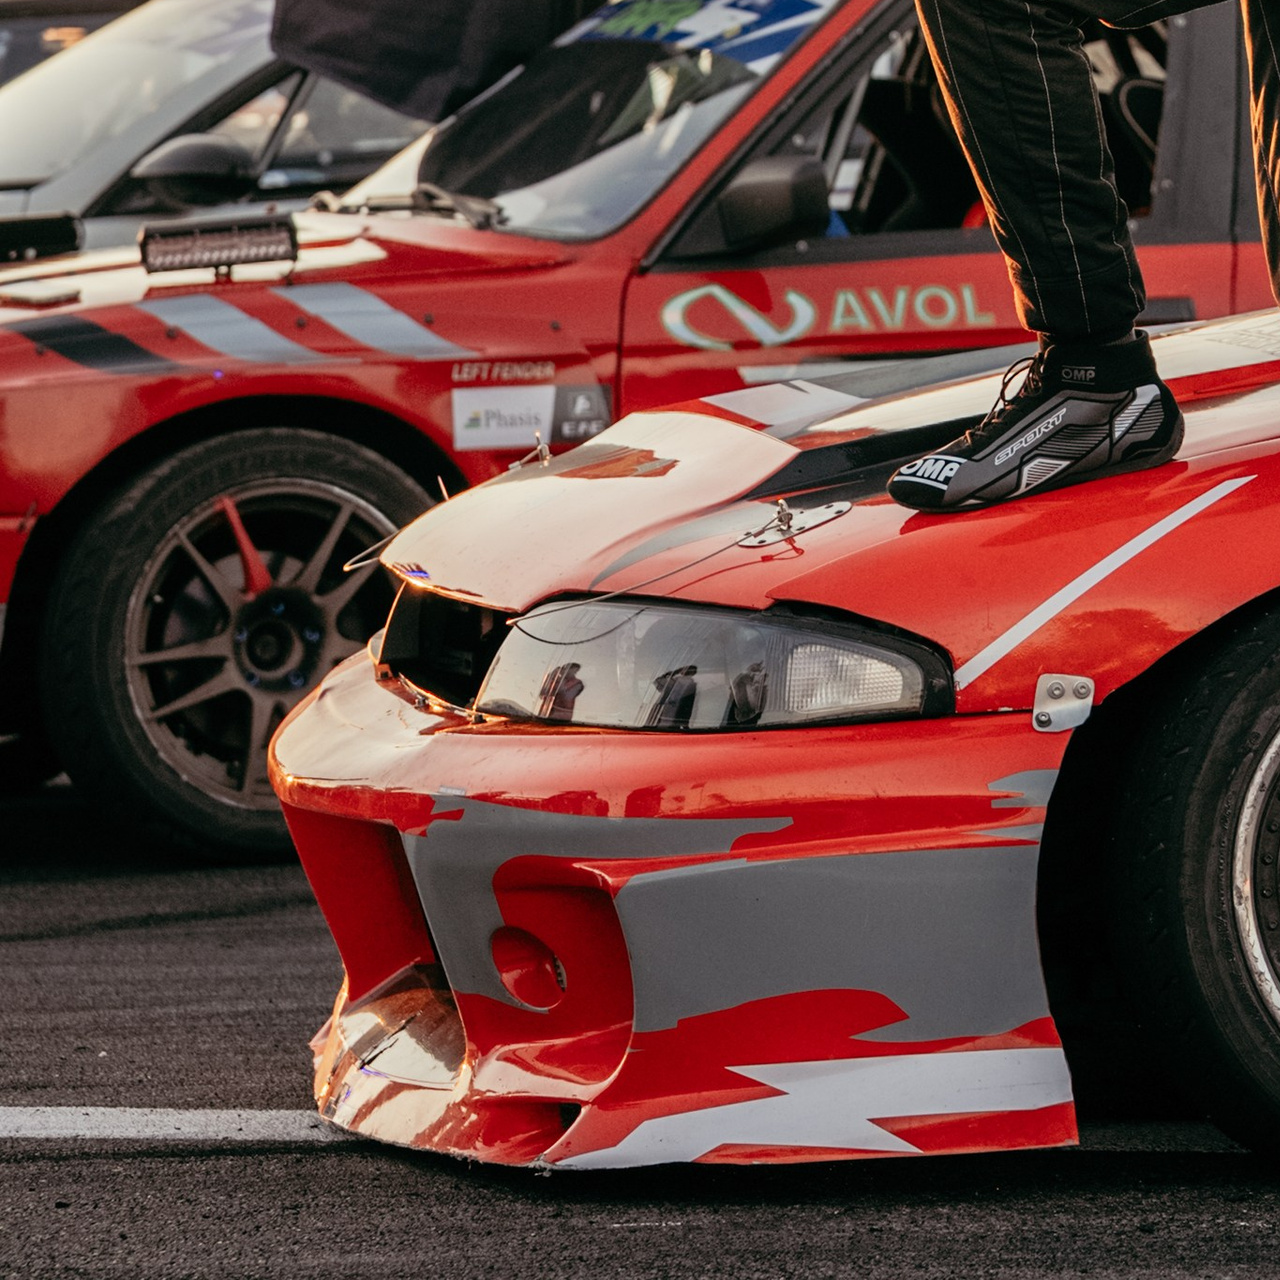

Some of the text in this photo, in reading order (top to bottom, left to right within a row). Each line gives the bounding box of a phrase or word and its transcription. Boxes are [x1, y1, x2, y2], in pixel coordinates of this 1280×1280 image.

[831, 284, 996, 331] AVOL
[452, 360, 556, 382] LEFT FENDER
[1062, 368, 1096, 382] OMP
[484, 408, 542, 429] Phasis
[994, 407, 1067, 466] SPORT
[899, 459, 961, 483] OMP
